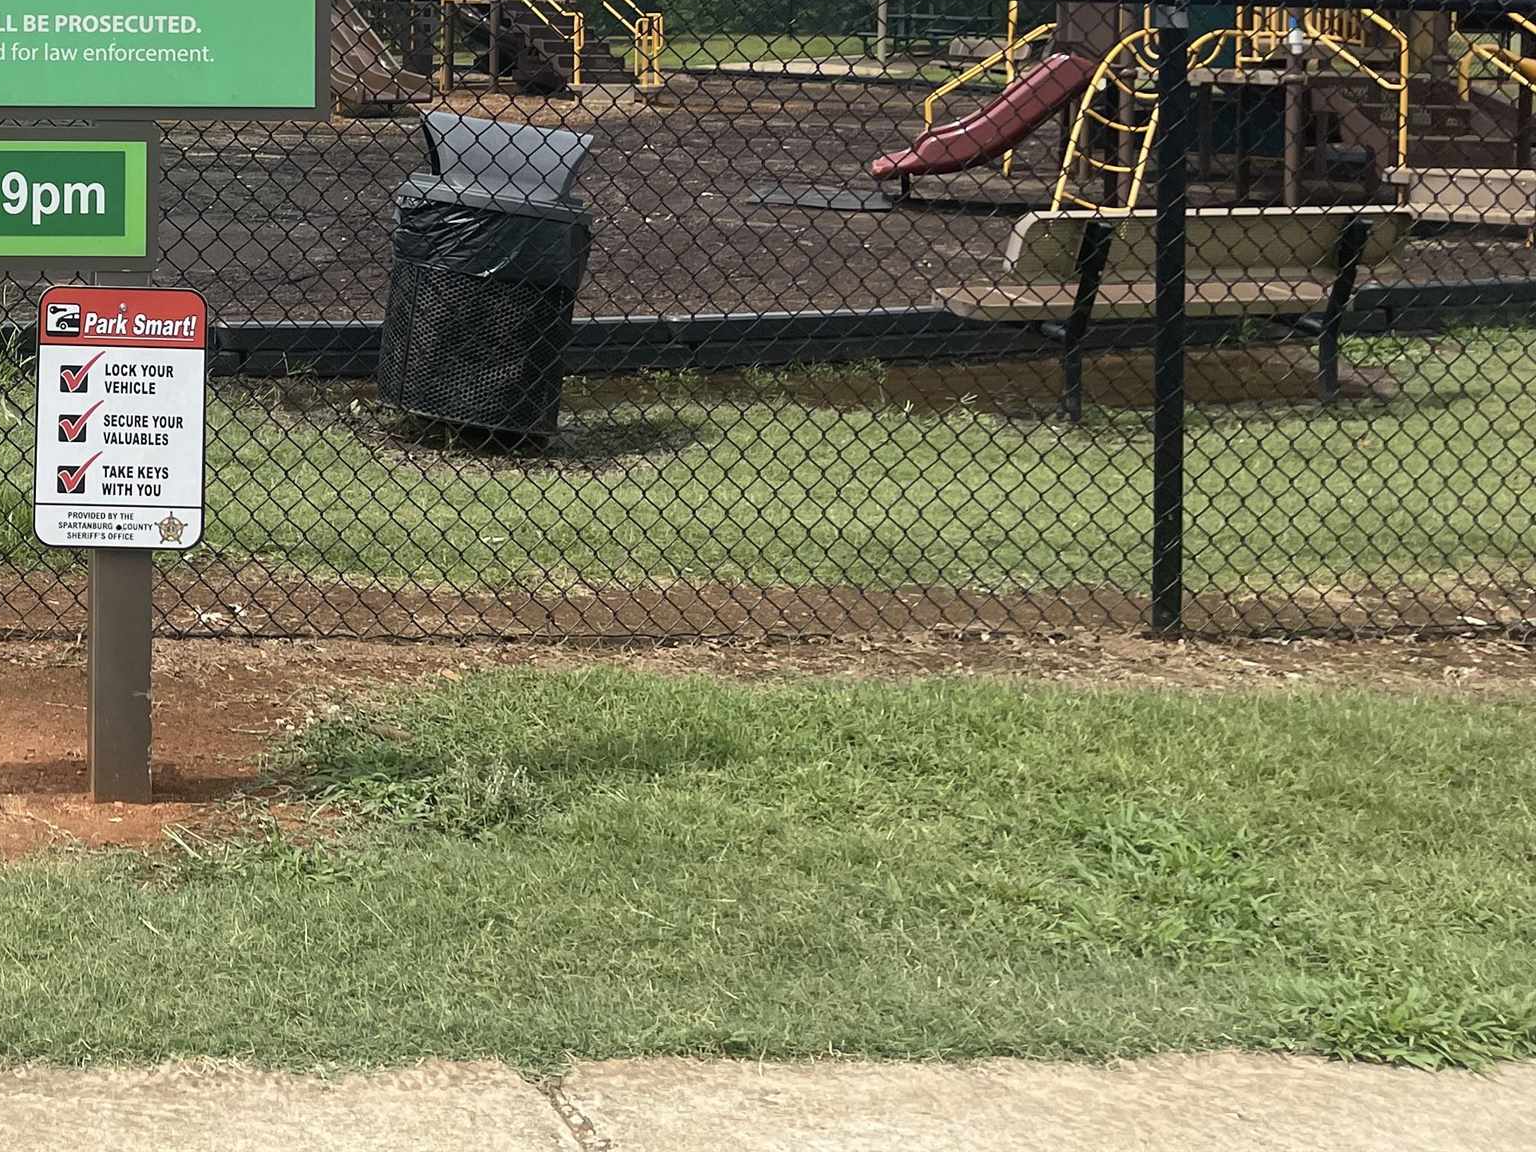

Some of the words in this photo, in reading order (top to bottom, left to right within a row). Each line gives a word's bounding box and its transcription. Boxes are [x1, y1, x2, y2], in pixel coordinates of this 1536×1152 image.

[23, 14, 50, 33] BE
[54, 14, 202, 34] PROSECUTED.
[10, 41, 40, 61] for
[44, 42, 79, 62] law
[82, 42, 215, 63] enforcement.
[1, 171, 106, 226] 9pm
[83, 312, 128, 335] Park
[133, 313, 198, 337] Smart!
[104, 363, 138, 378] LOCK
[140, 364, 175, 379] YOUR
[104, 380, 157, 395] VEHICLE
[103, 413, 149, 429] SECURE
[151, 415, 184, 430] YOUR
[102, 431, 169, 447] VALUABLES
[101, 465, 134, 479] TAKE
[137, 465, 169, 480] KEYS
[101, 482, 133, 497] WITH
[136, 483, 162, 497] YOU
[67, 511, 107, 520] PROVIDED
[107, 512, 119, 520] BY
[119, 512, 134, 521] THE
[57, 521, 114, 531] SPARTANBURG
[122, 522, 154, 532] COUNTY
[107, 532, 134, 541] OFFICE
